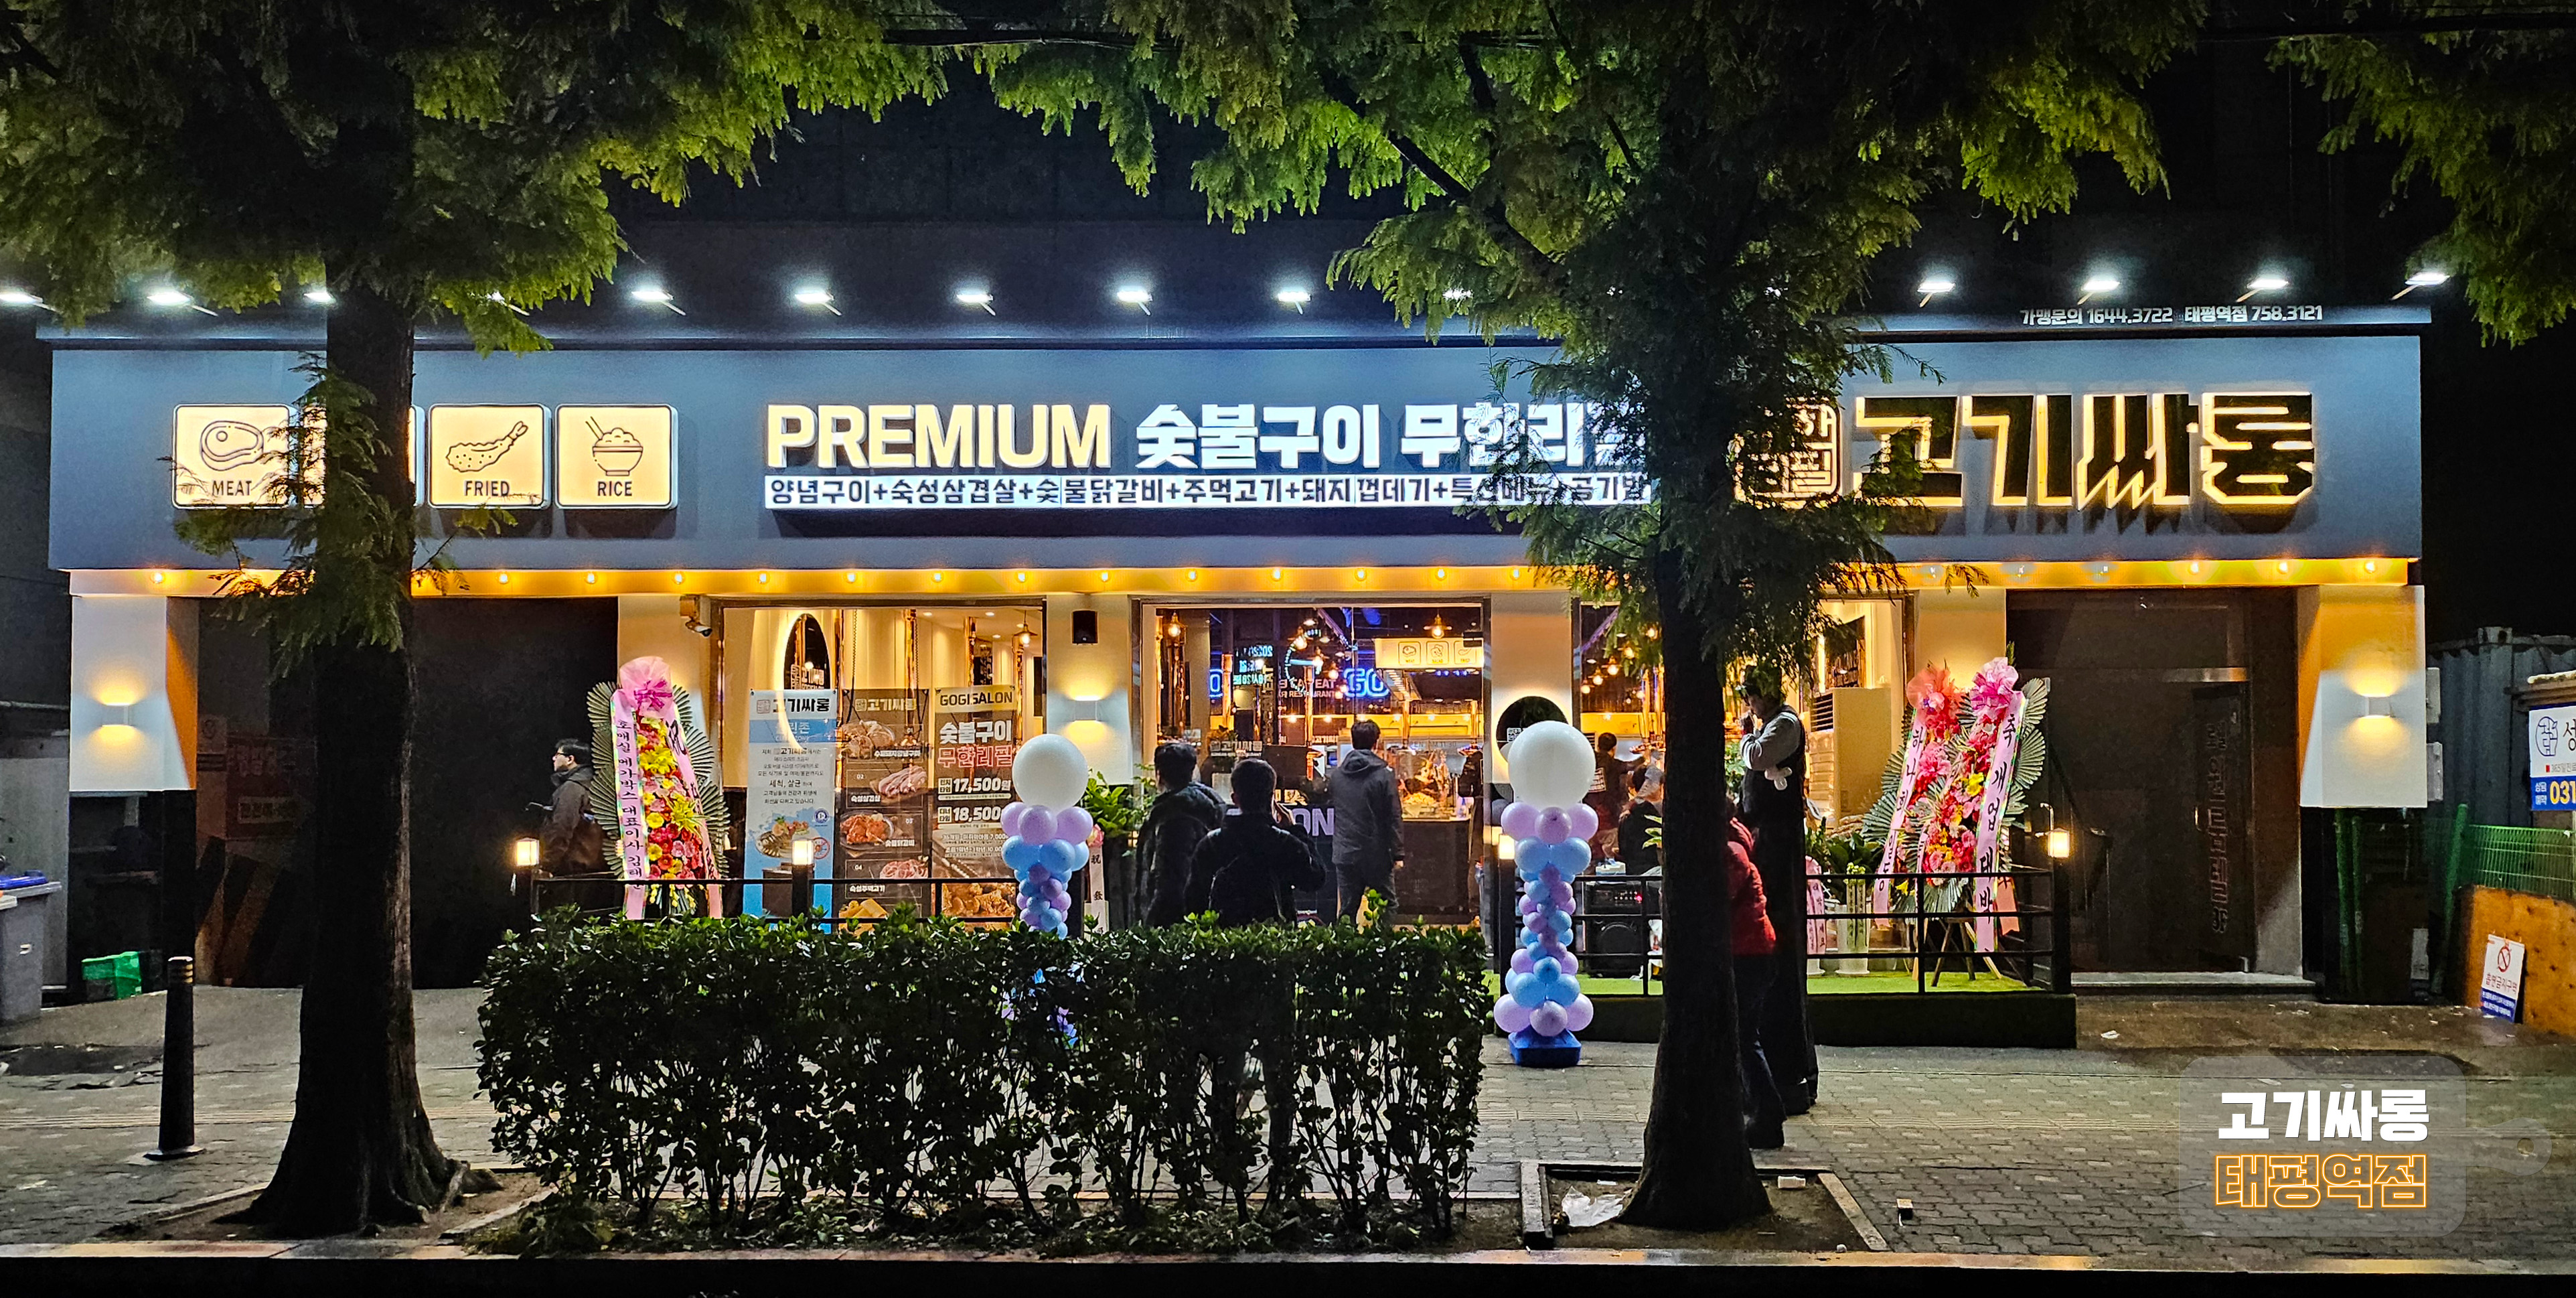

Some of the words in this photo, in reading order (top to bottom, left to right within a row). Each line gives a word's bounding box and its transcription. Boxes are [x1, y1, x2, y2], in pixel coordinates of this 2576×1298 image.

[2020, 308, 2083, 326] 가맹문의
[2087, 307, 2174, 324] 1644.3722
[2184, 305, 2249, 323] 태평역점
[2251, 305, 2323, 321] 758.3121
[767, 404, 1112, 469] PREMIUM
[1136, 403, 1380, 470] 숯불구이
[1855, 392, 2315, 510] 고기싸롱
[212, 480, 252, 497] MEAT
[464, 480, 510, 497] FRIED
[597, 480, 632, 497] RICE
[867, 698, 917, 711] 고기싸롱
[1288, 690, 1335, 698] RESURANT
[939, 719, 1012, 745] 숯불구이
[937, 744, 1013, 768] 무한리필
[2550, 780, 2576, 805] 031
[622, 805, 643, 851] 대표이사
